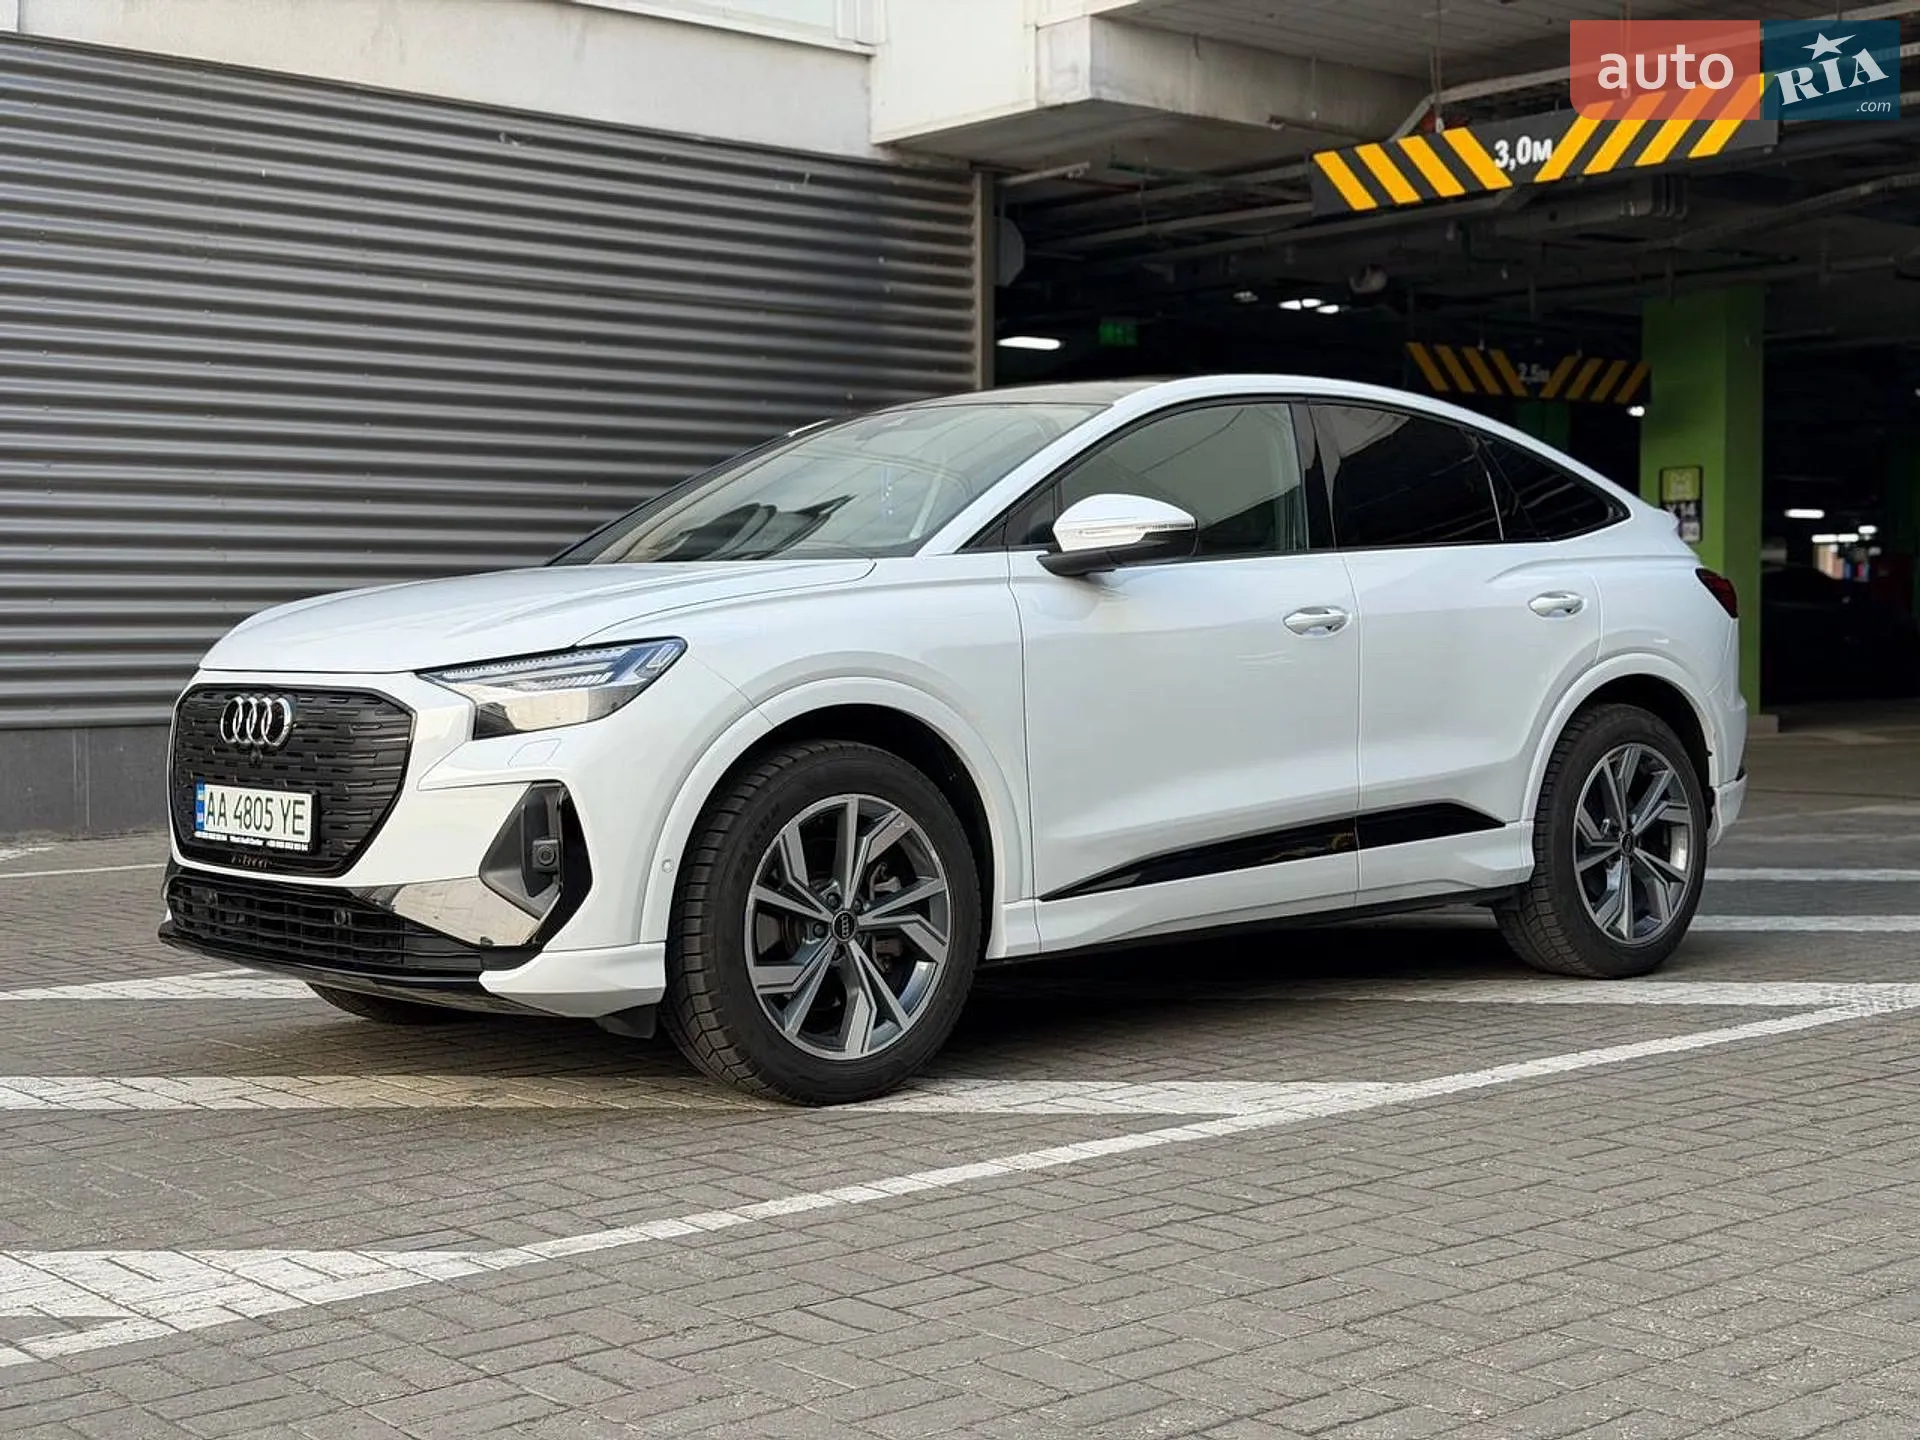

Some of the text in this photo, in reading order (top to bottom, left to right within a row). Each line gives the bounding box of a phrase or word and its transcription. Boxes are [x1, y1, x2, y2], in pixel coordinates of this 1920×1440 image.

[206, 791, 306, 836] AA 4805 YE
